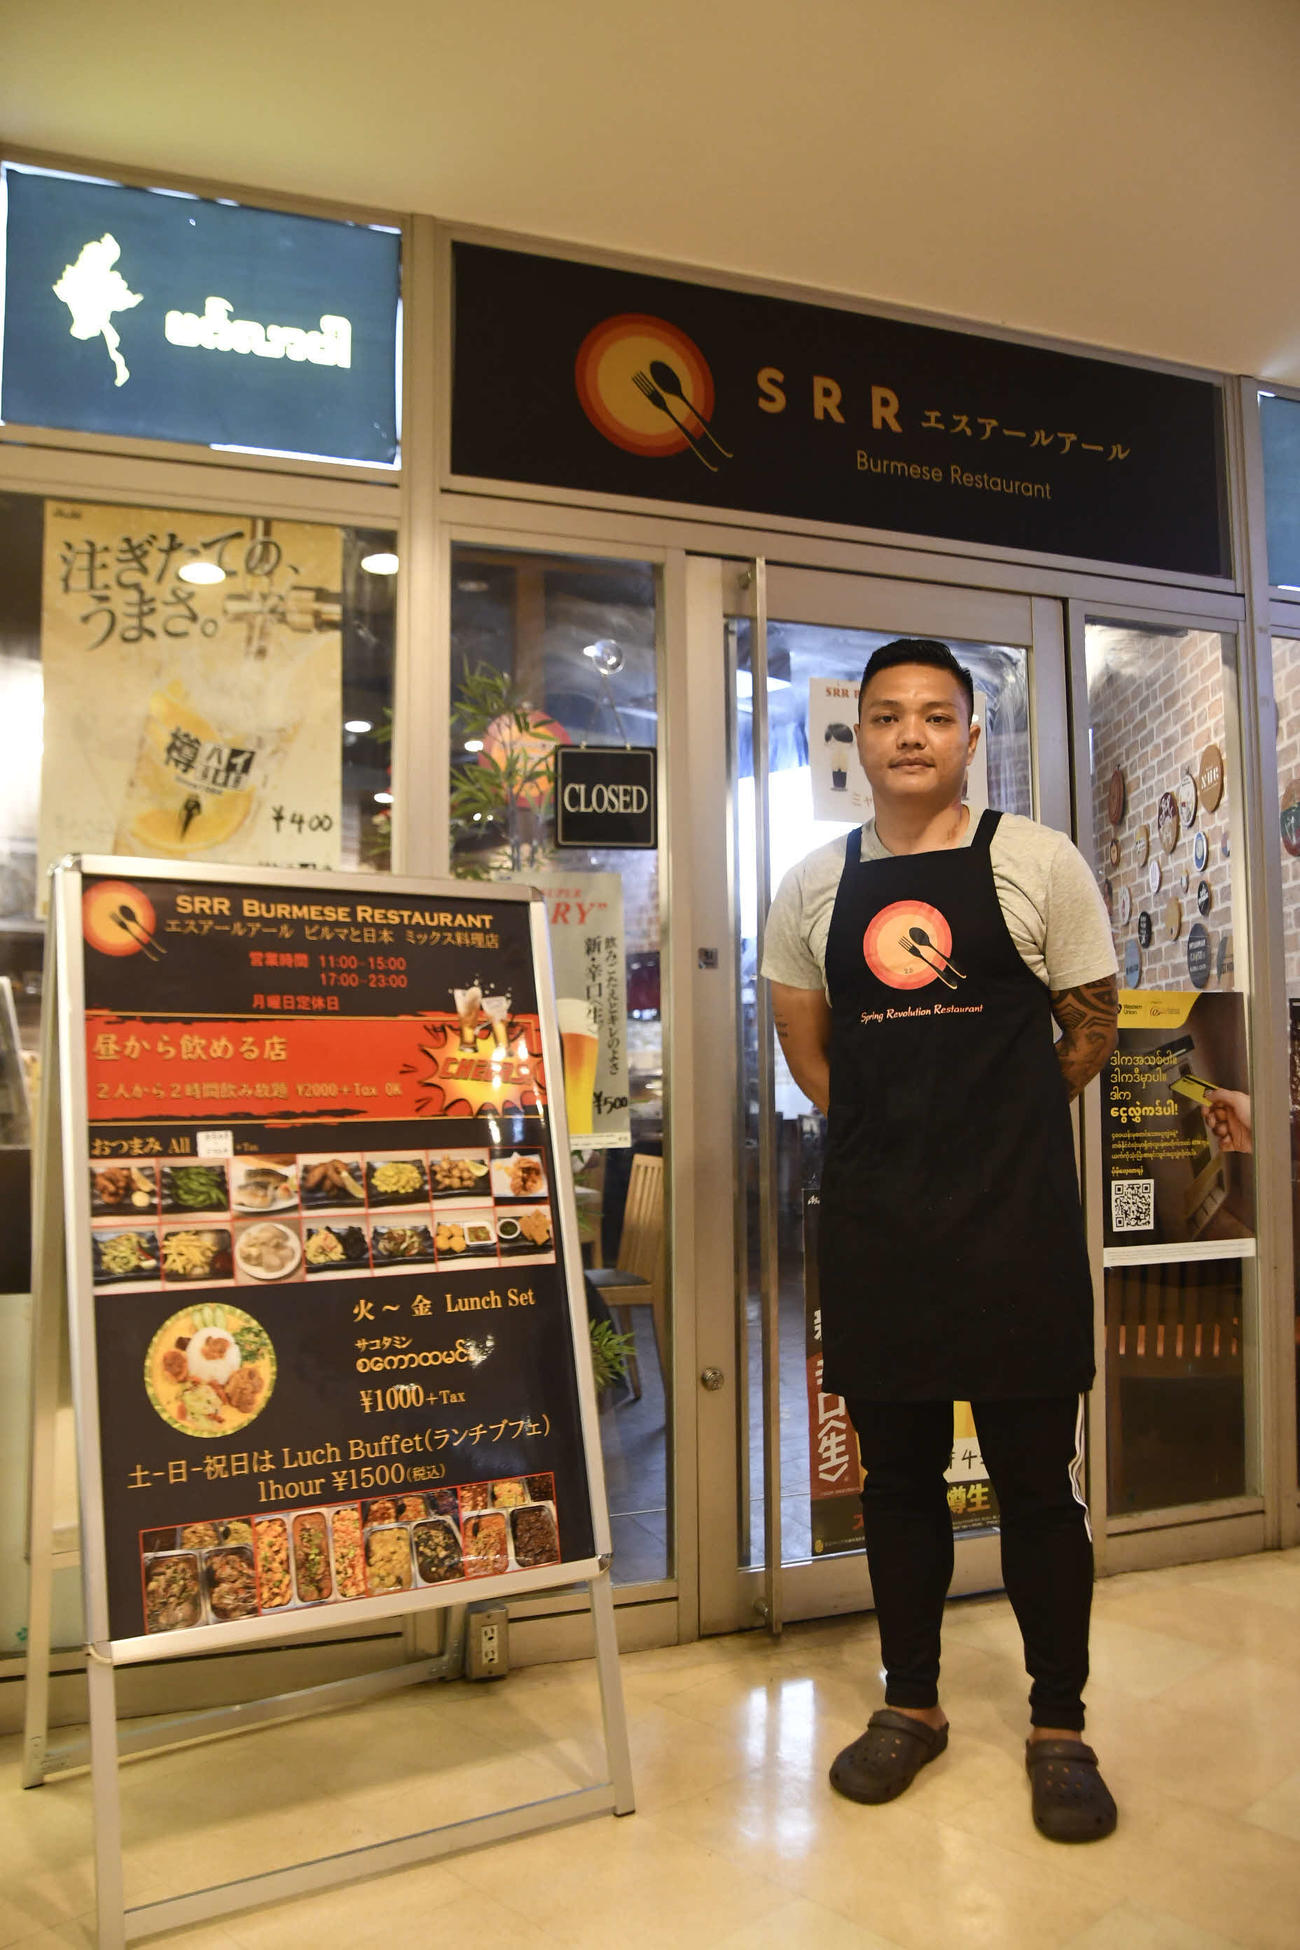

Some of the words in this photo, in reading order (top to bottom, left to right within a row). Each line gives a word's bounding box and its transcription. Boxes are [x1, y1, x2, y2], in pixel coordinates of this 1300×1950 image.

[921, 409, 1131, 462] エスアールアール
[856, 449, 943, 483] Burmese
[950, 464, 1053, 500] Restaurant
[80, 587, 218, 650] うまさ。
[563, 783, 648, 814] CLOSED
[272, 804, 333, 834] ¥400
[175, 894, 232, 917] SRR
[242, 898, 352, 923] BURMESE
[356, 904, 494, 930] RESTAURANT
[165, 918, 295, 939] エスアールアール
[304, 924, 395, 944] ビルマと日本
[405, 929, 500, 949] ミックス料理店
[249, 951, 309, 968] 営業時間
[252, 993, 341, 1012] 月曜日定休日
[860, 1011, 884, 1024] Spring
[886, 1006, 932, 1020] Revolution
[933, 1003, 984, 1015] Restaurant
[93, 1032, 289, 1062] 昼から飲める店
[439, 1056, 534, 1085] CHERS
[592, 1090, 628, 1115] ¥500
[91, 1136, 164, 1156] おつまみ
[168, 1137, 191, 1154] All
[445, 1290, 503, 1313] Lunch
[507, 1287, 536, 1307] Set
[355, 1335, 413, 1352] サコタミン
[282, 1442, 342, 1470] Luch
[257, 1477, 326, 1503] 1hour
